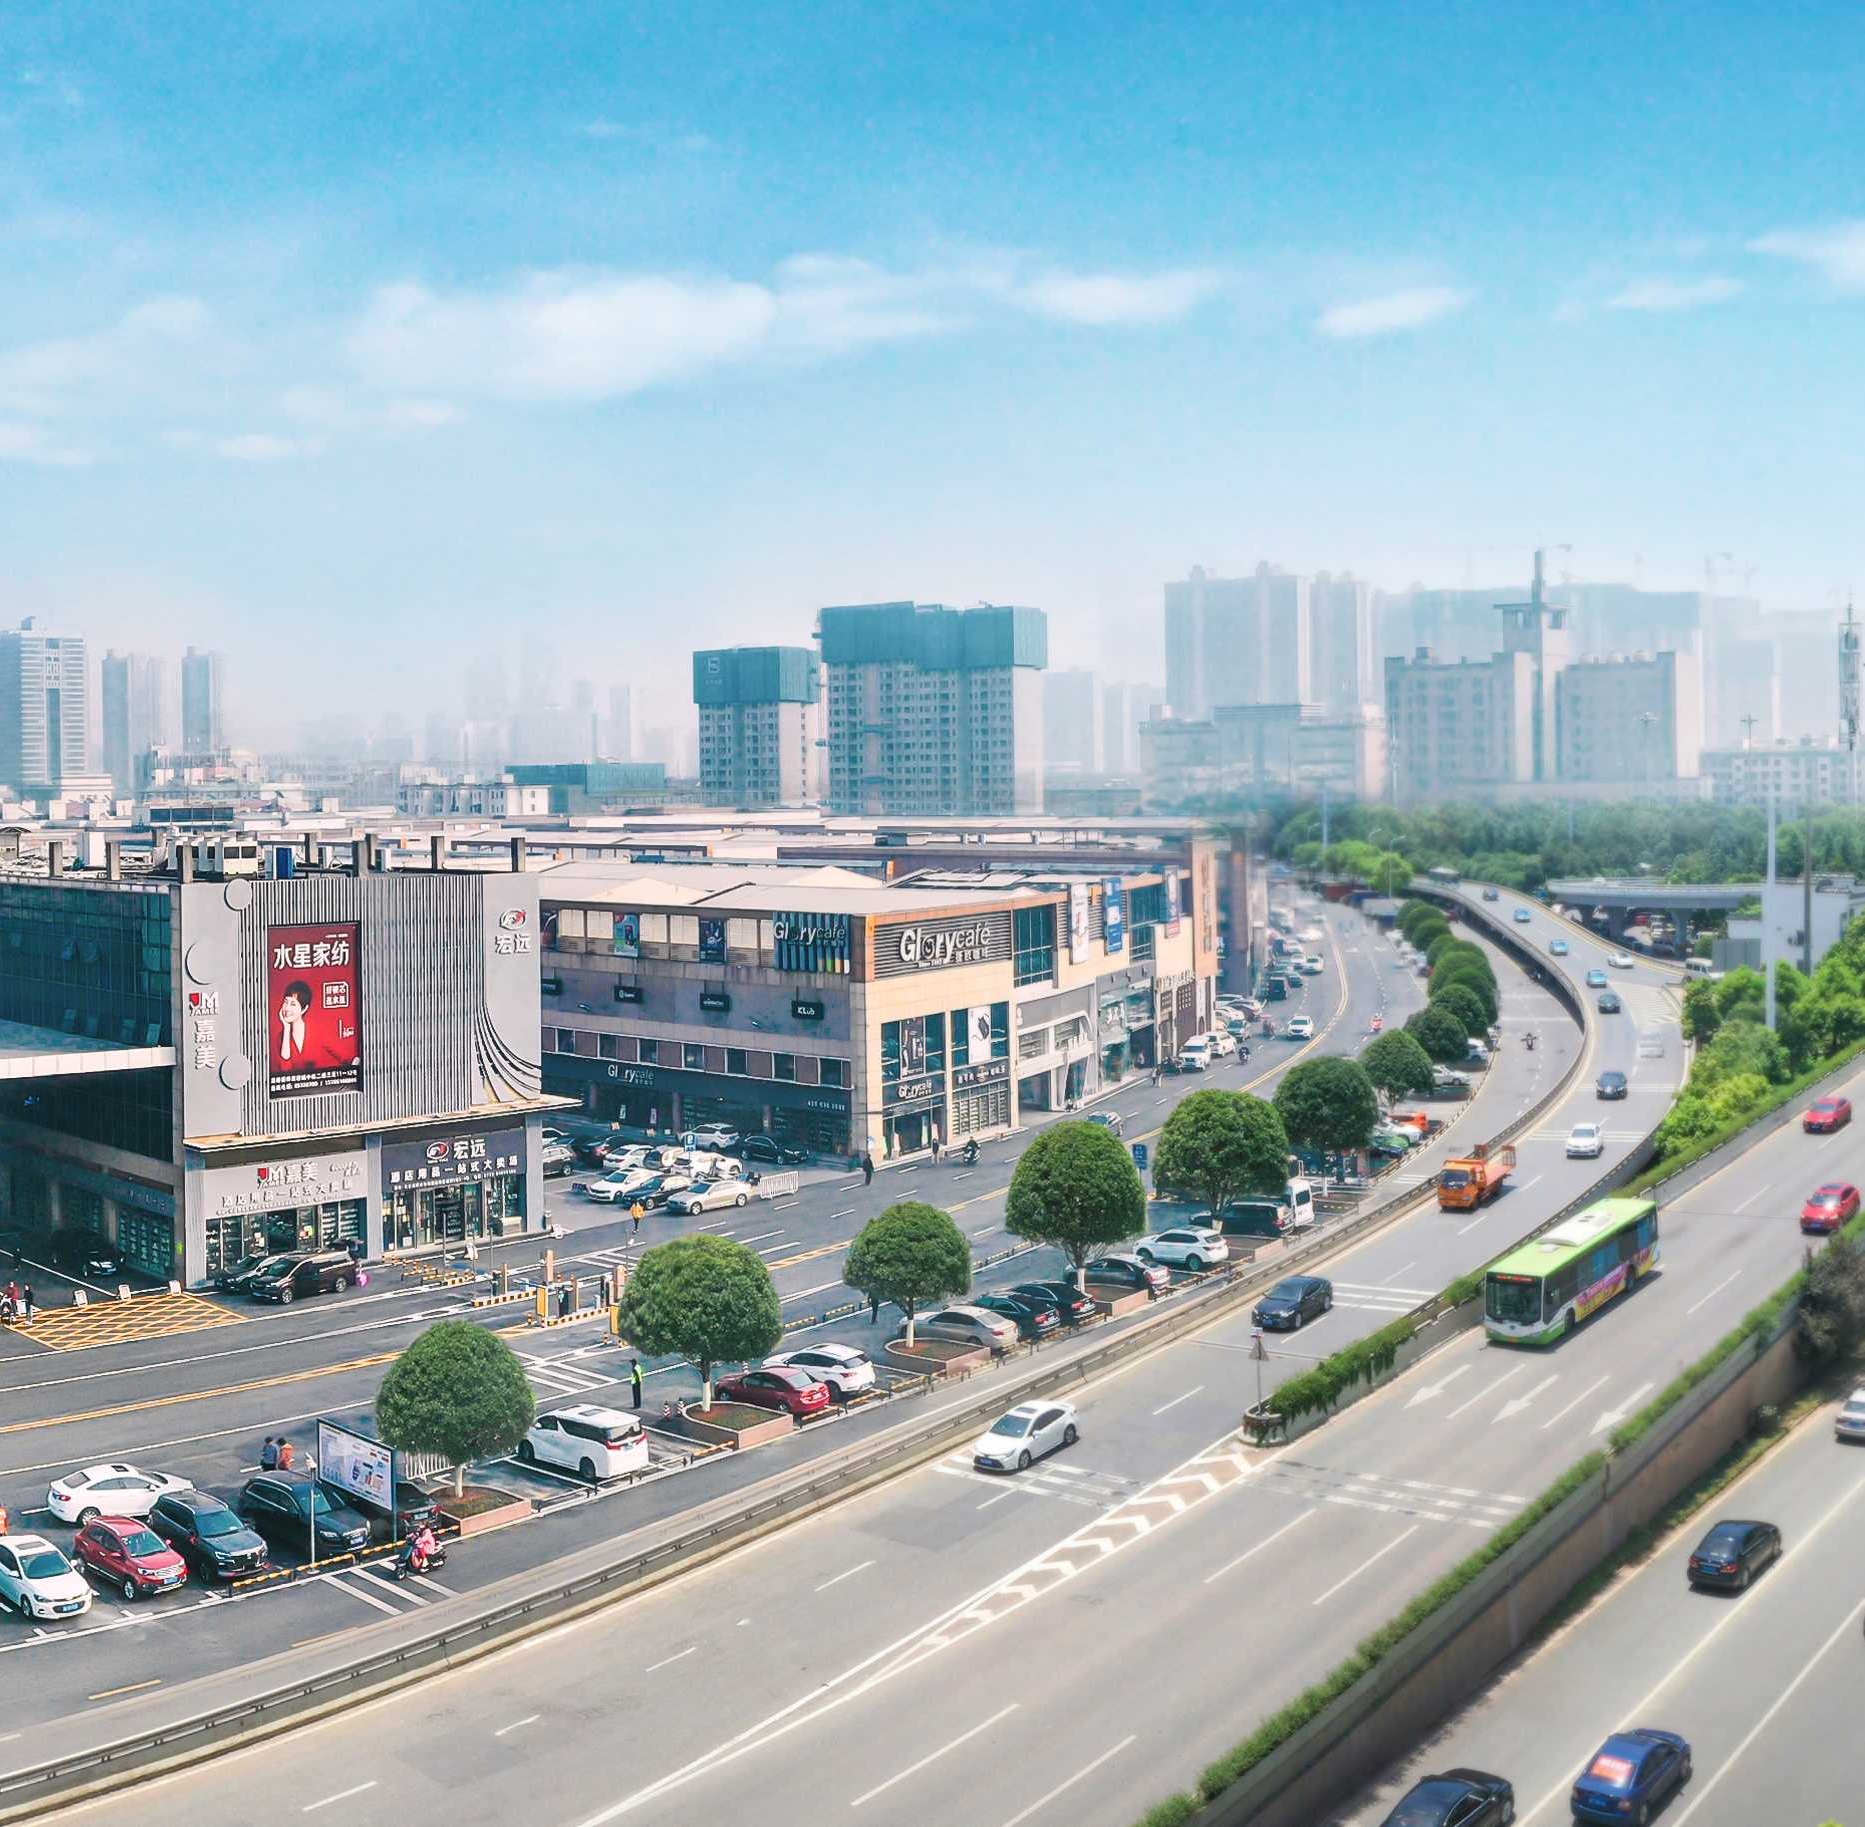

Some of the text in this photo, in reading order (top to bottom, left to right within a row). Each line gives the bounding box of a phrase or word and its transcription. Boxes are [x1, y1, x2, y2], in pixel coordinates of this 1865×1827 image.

[495, 933, 531, 955] 宏远
[274, 942, 350, 970] 水星家纺
[195, 1019, 216, 1070] 嘉美
[453, 1139, 487, 1159] 宏远
[283, 1161, 318, 1183] 嘉美
